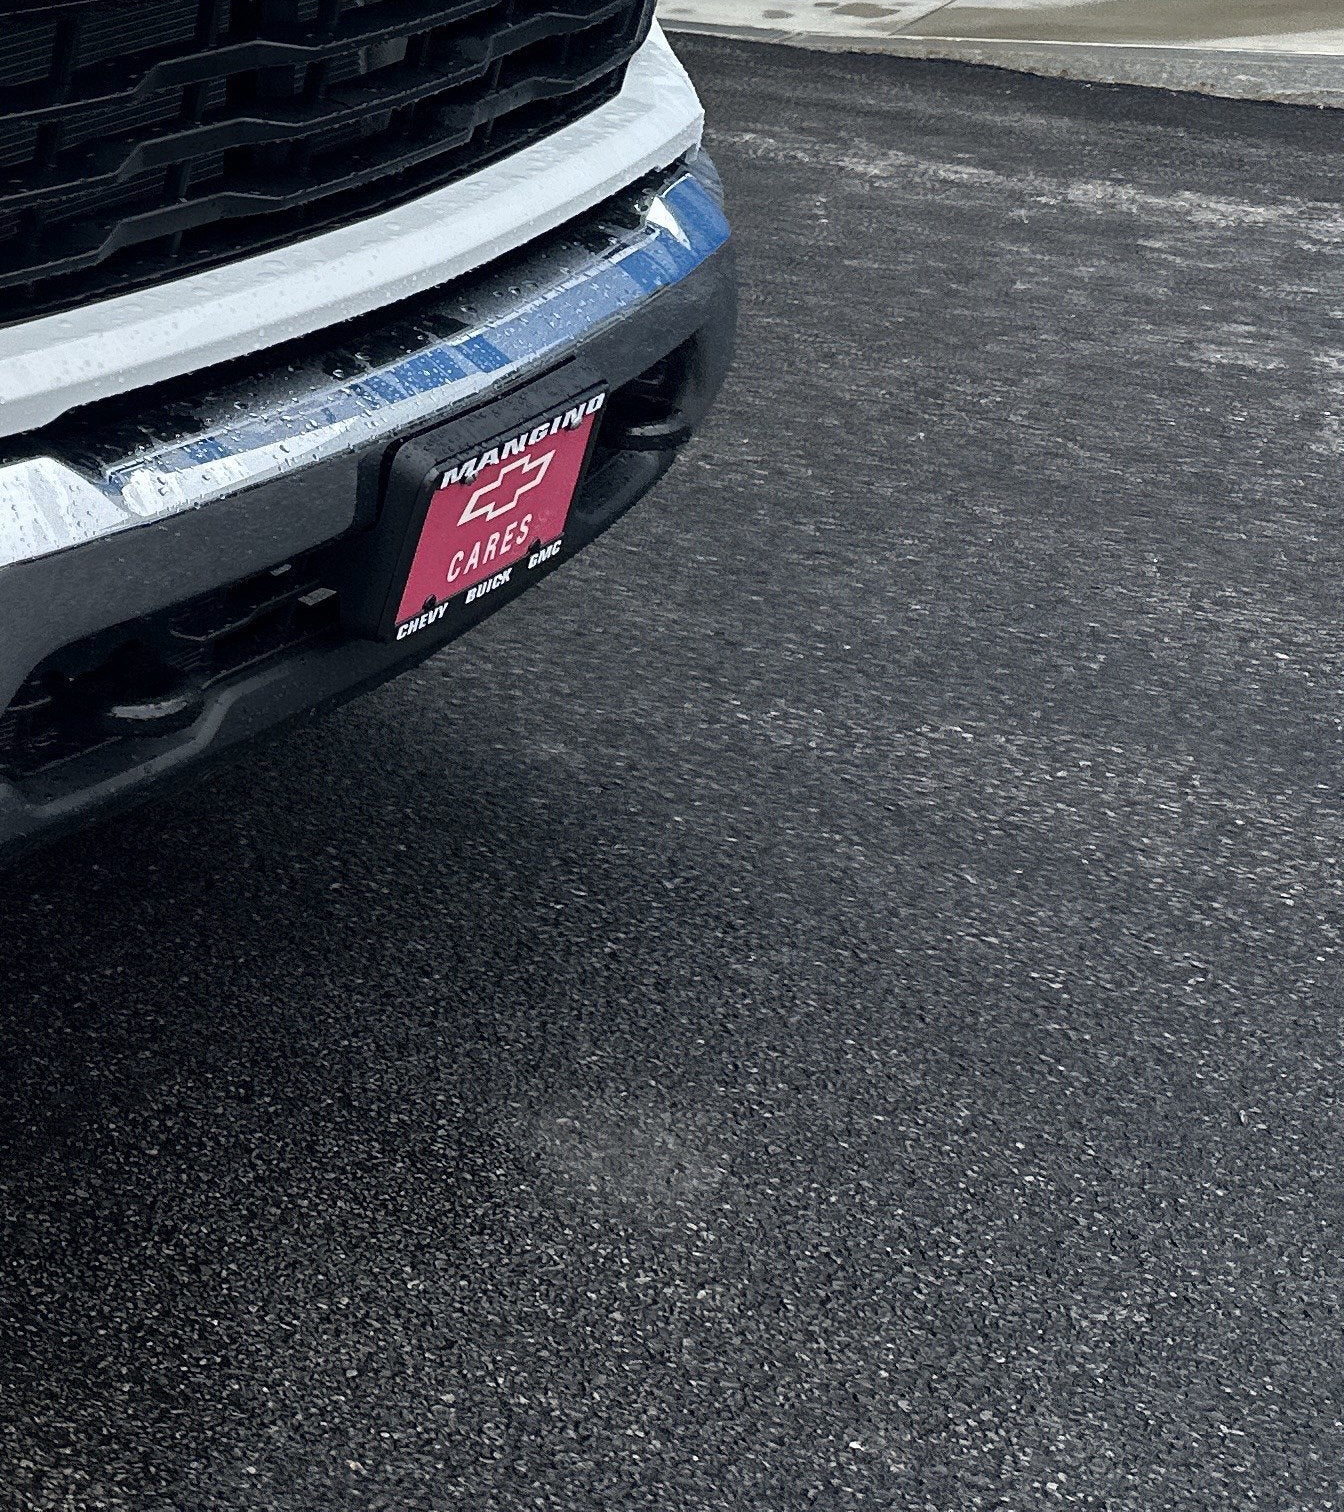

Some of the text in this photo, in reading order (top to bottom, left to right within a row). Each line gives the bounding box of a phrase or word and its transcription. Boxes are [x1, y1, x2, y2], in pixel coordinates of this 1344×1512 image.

[440, 393, 606, 489] MANGINO
[396, 540, 562, 641] CHEVY BUICK GMC
[446, 513, 532, 583] CARES
